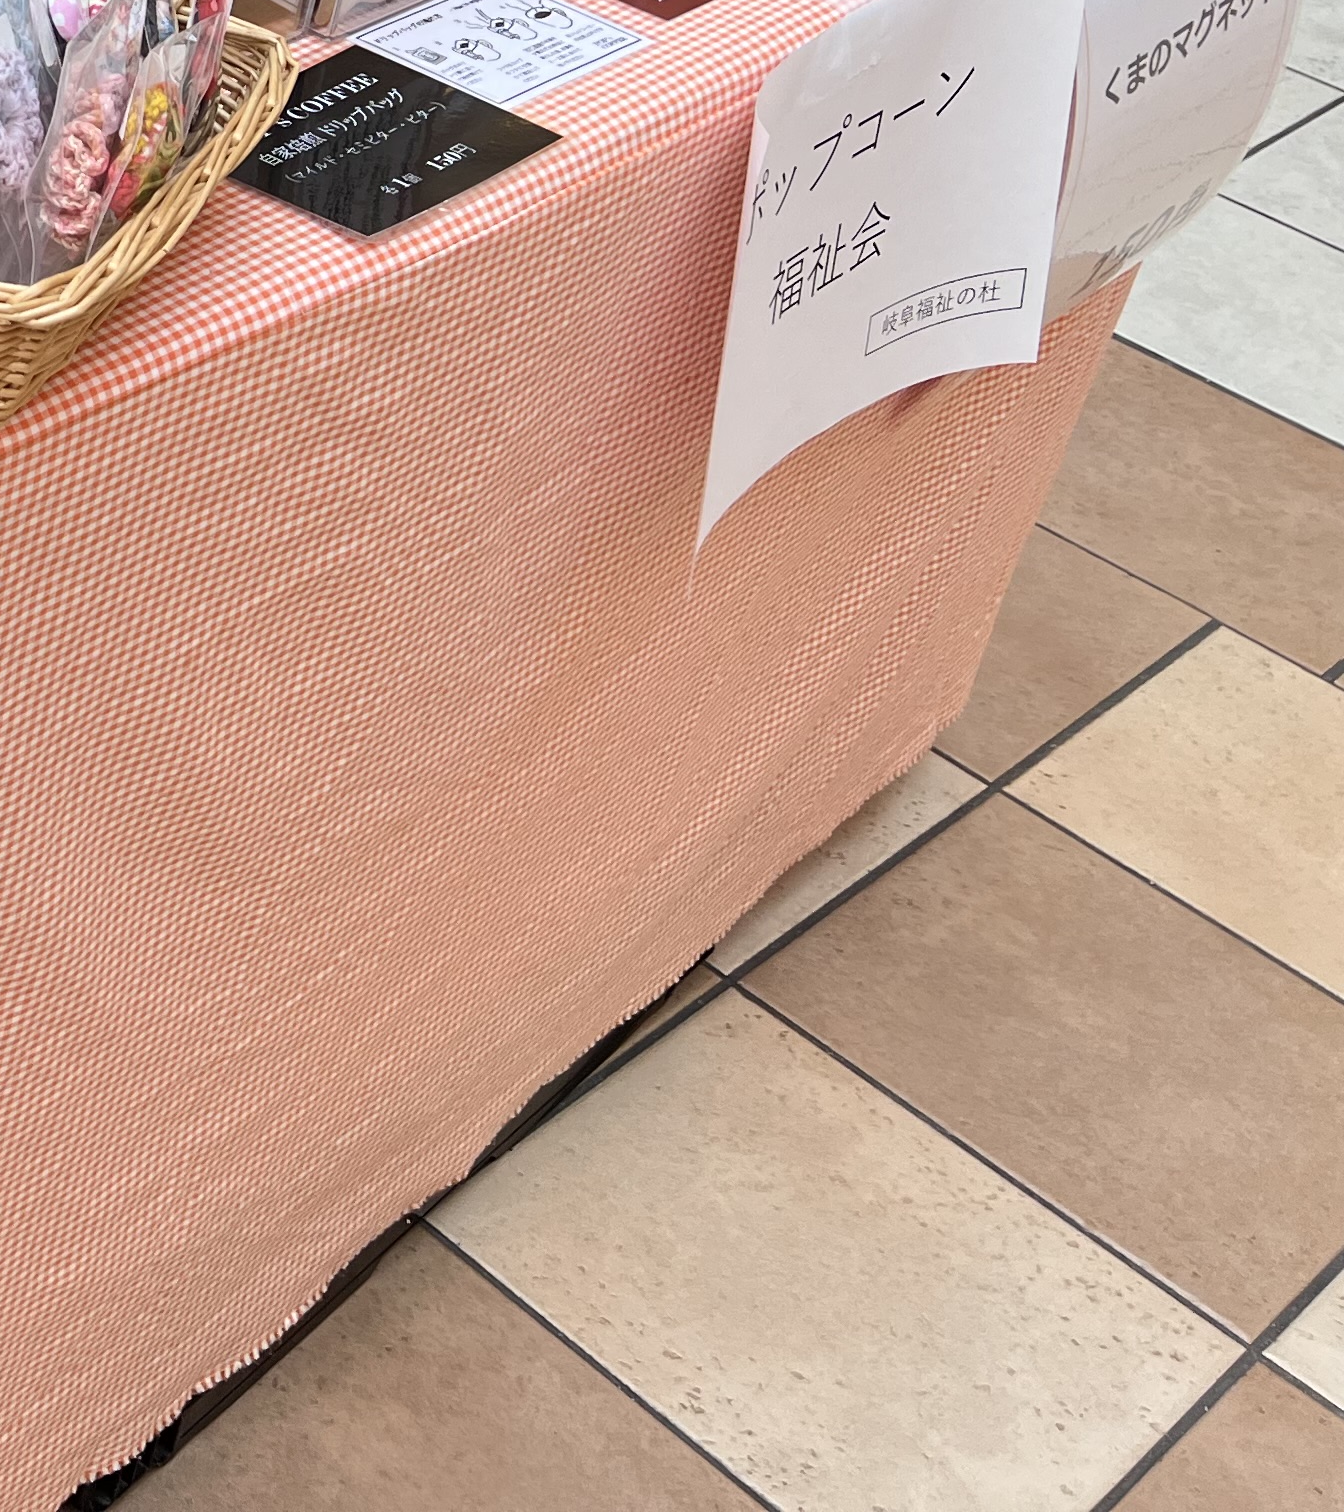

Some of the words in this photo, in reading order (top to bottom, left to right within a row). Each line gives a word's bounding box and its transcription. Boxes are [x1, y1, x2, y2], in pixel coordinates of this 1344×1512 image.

[258, 131, 328, 167] 自家焙煎
[318, 87, 405, 138] ドリップバッグ
[287, 70, 380, 120] COFFEE
[426, 140, 478, 173] 150円
[744, 66, 975, 247] ポップコーン
[768, 200, 892, 326] 福祉会
[881, 280, 1002, 337] 岐阜福祉の杜
